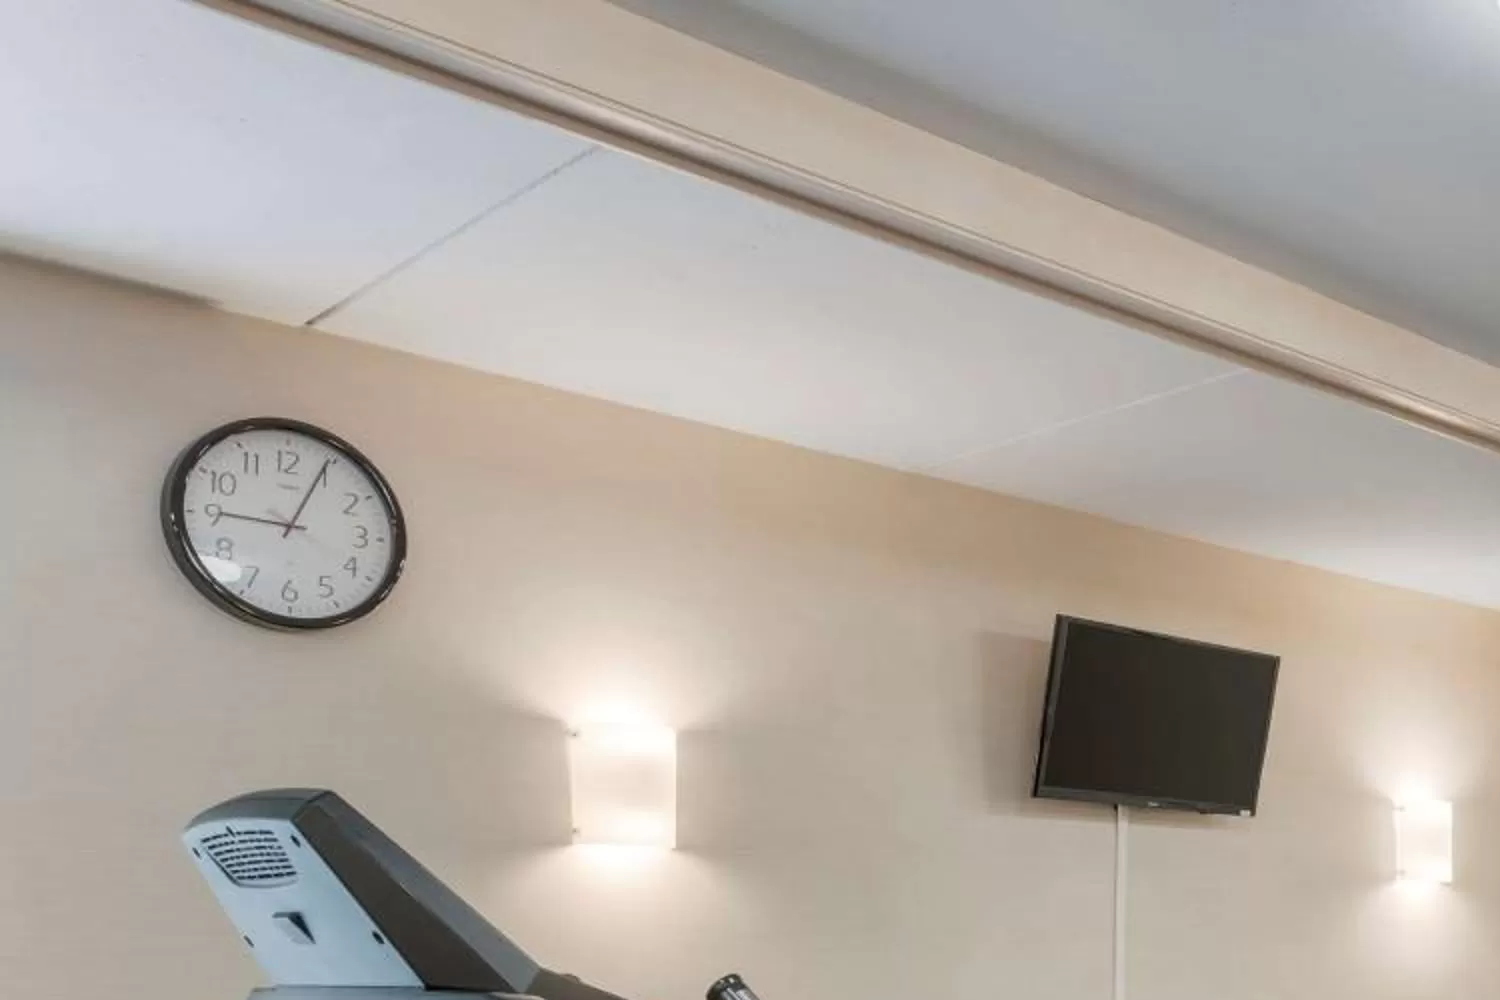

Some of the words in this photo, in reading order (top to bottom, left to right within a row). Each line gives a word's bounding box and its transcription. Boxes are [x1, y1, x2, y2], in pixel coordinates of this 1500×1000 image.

[243, 451, 260, 476] 11
[277, 449, 300, 475] 12
[210, 470, 238, 496] 10
[203, 503, 223, 527] 9
[342, 492, 358, 517] 2
[215, 536, 235, 561] 8
[351, 524, 369, 549] 3
[242, 565, 260, 588] 7
[342, 556, 358, 579] 4
[280, 579, 299, 603] 6
[318, 575, 335, 599] 5
